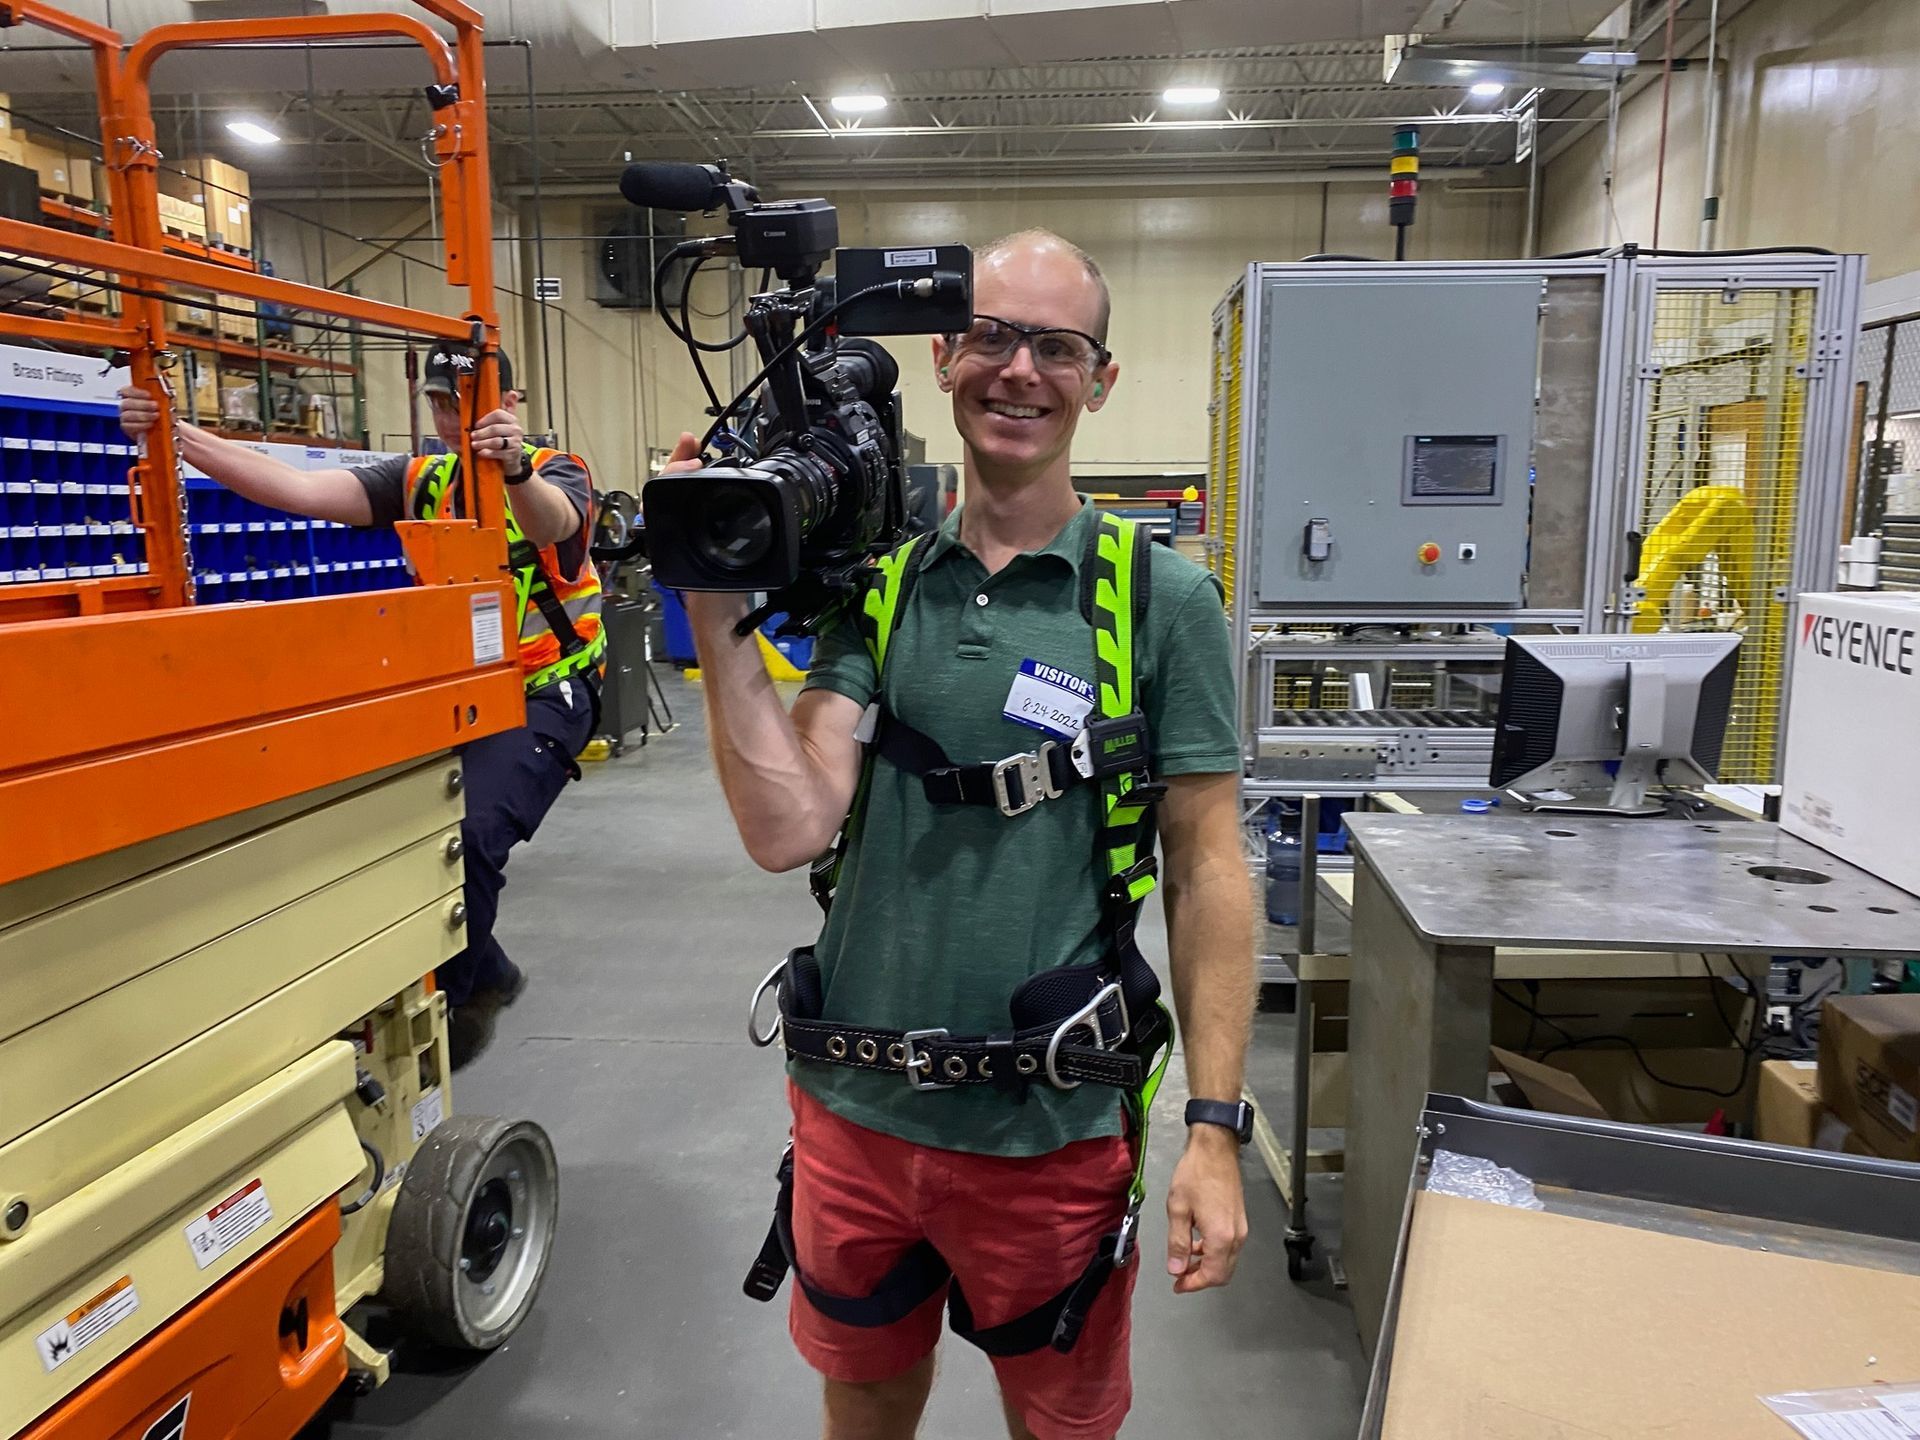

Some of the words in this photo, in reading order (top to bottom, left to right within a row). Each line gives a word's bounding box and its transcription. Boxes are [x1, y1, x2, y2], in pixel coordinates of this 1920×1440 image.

[12, 362, 44, 380] Brass
[46, 366, 84, 387] Fittings
[1803, 613, 1916, 676] KEYENCE
[1103, 733, 1138, 754] MILLER
